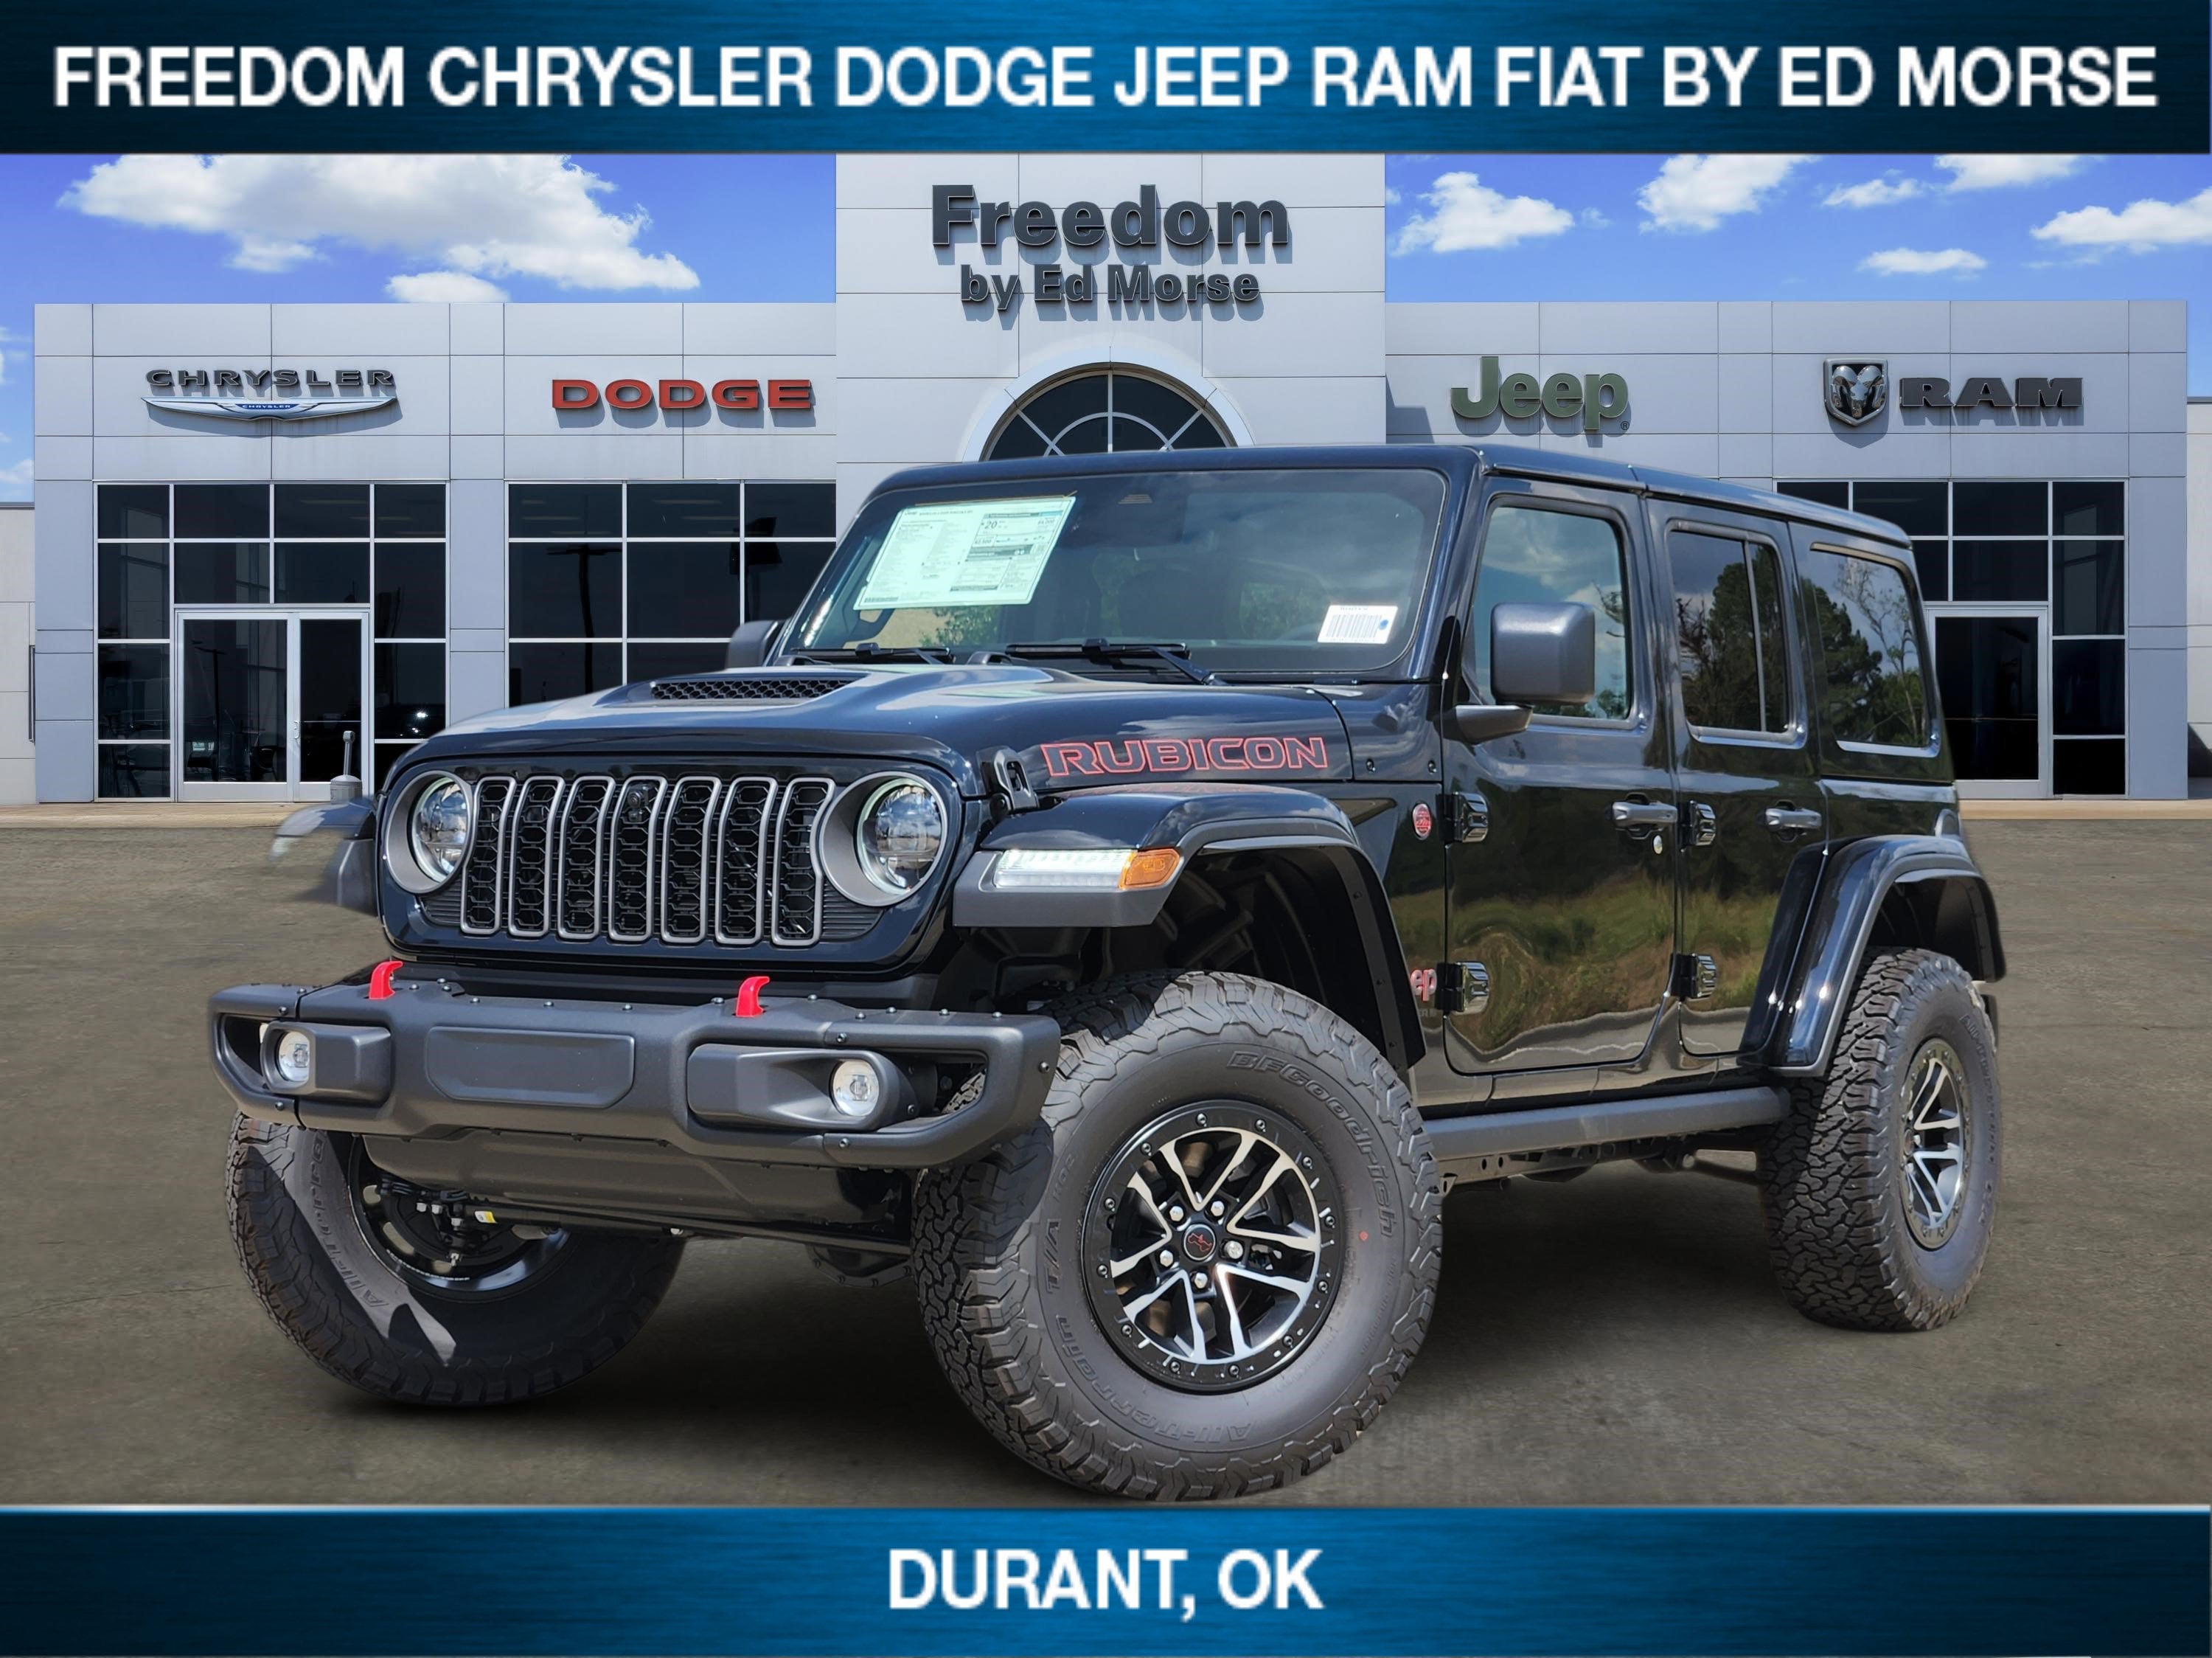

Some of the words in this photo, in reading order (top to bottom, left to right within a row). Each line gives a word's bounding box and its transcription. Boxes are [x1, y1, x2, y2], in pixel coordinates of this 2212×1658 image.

[932, 184, 1289, 246] Freedom
[961, 264, 1019, 311] by
[1034, 264, 1093, 301] Ed
[1107, 264, 1260, 302] Morse
[145, 369, 395, 386] CHRYSLER
[552, 378, 813, 409] DODGE
[1450, 355, 1629, 431] Jeep
[1899, 378, 2083, 406] RAM
[1040, 737, 1328, 777] RUBICON
[1227, 1050, 1395, 1238] BFGoodrich
[1055, 1314, 1252, 1443] All-Terrain
